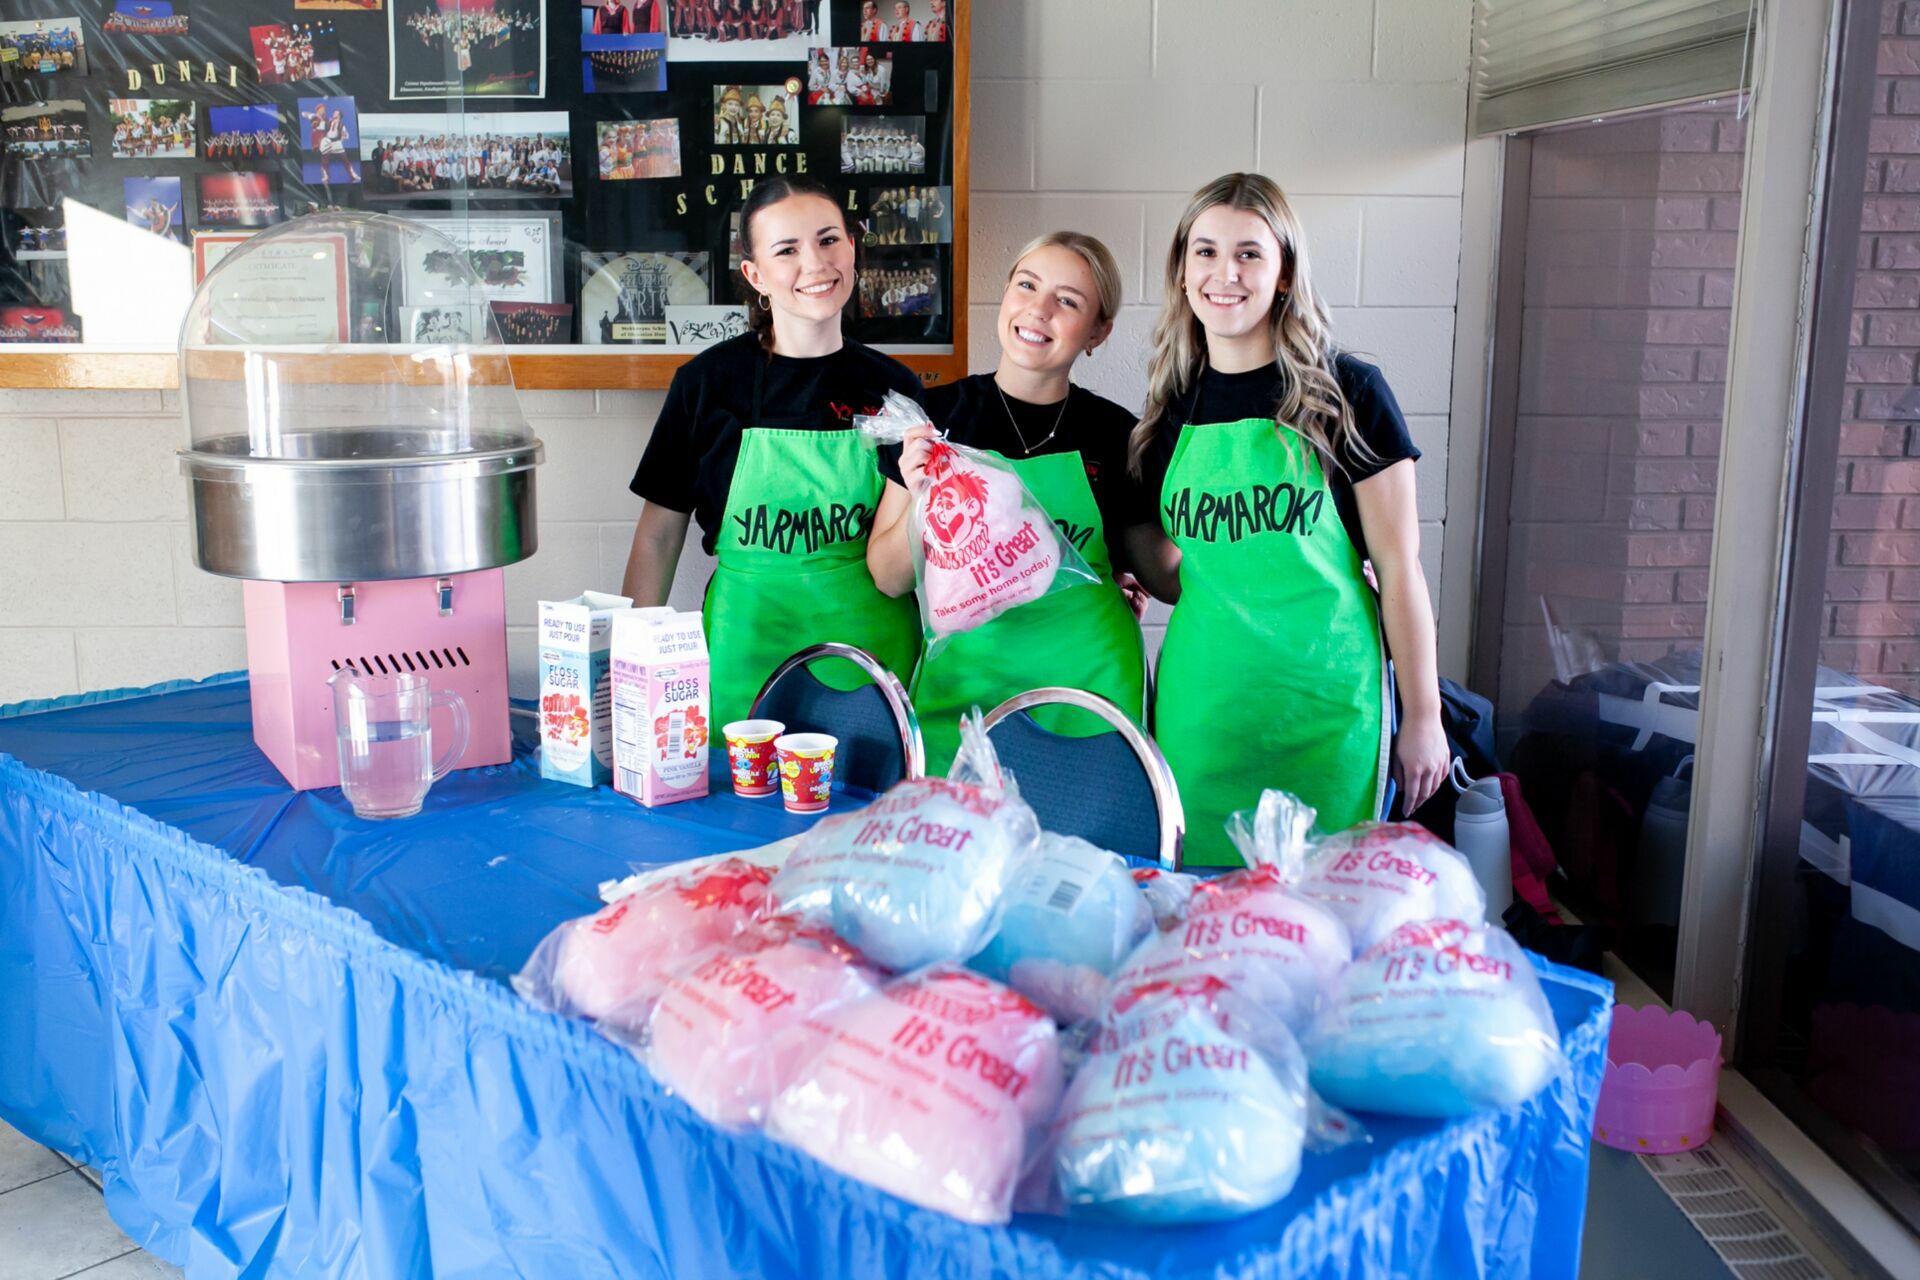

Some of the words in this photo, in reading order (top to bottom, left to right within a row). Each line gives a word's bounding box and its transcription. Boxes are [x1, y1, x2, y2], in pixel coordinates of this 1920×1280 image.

[127, 60, 238, 90] DUNAI
[710, 152, 808, 175] DANCE
[676, 178, 858, 215] SCHL
[1164, 482, 1323, 543] YARMAROK!
[994, 521, 1040, 567] Great
[934, 603, 957, 618] Take
[960, 592, 988, 609] some
[989, 575, 1019, 595] home
[1020, 554, 1053, 579] today!
[544, 618, 564, 629] READY
[565, 621, 573, 631] TO
[574, 624, 586, 633] USE
[549, 630, 563, 640] JUST
[564, 633, 580, 642] POUR
[677, 632, 686, 641] TO
[687, 630, 702, 639] USE
[659, 644, 676, 654] JUST
[678, 642, 698, 652] POUR
[549, 665, 579, 679] FLOSS
[549, 675, 579, 689] SUGAR
[665, 678, 699, 692] FLOSS
[665, 689, 699, 703] SUGAR
[897, 815, 973, 851] Great
[1231, 912, 1309, 945] Great
[1434, 949, 1514, 983] Great
[947, 1034, 1029, 1100] Great
[1164, 1036, 1248, 1076] Great
